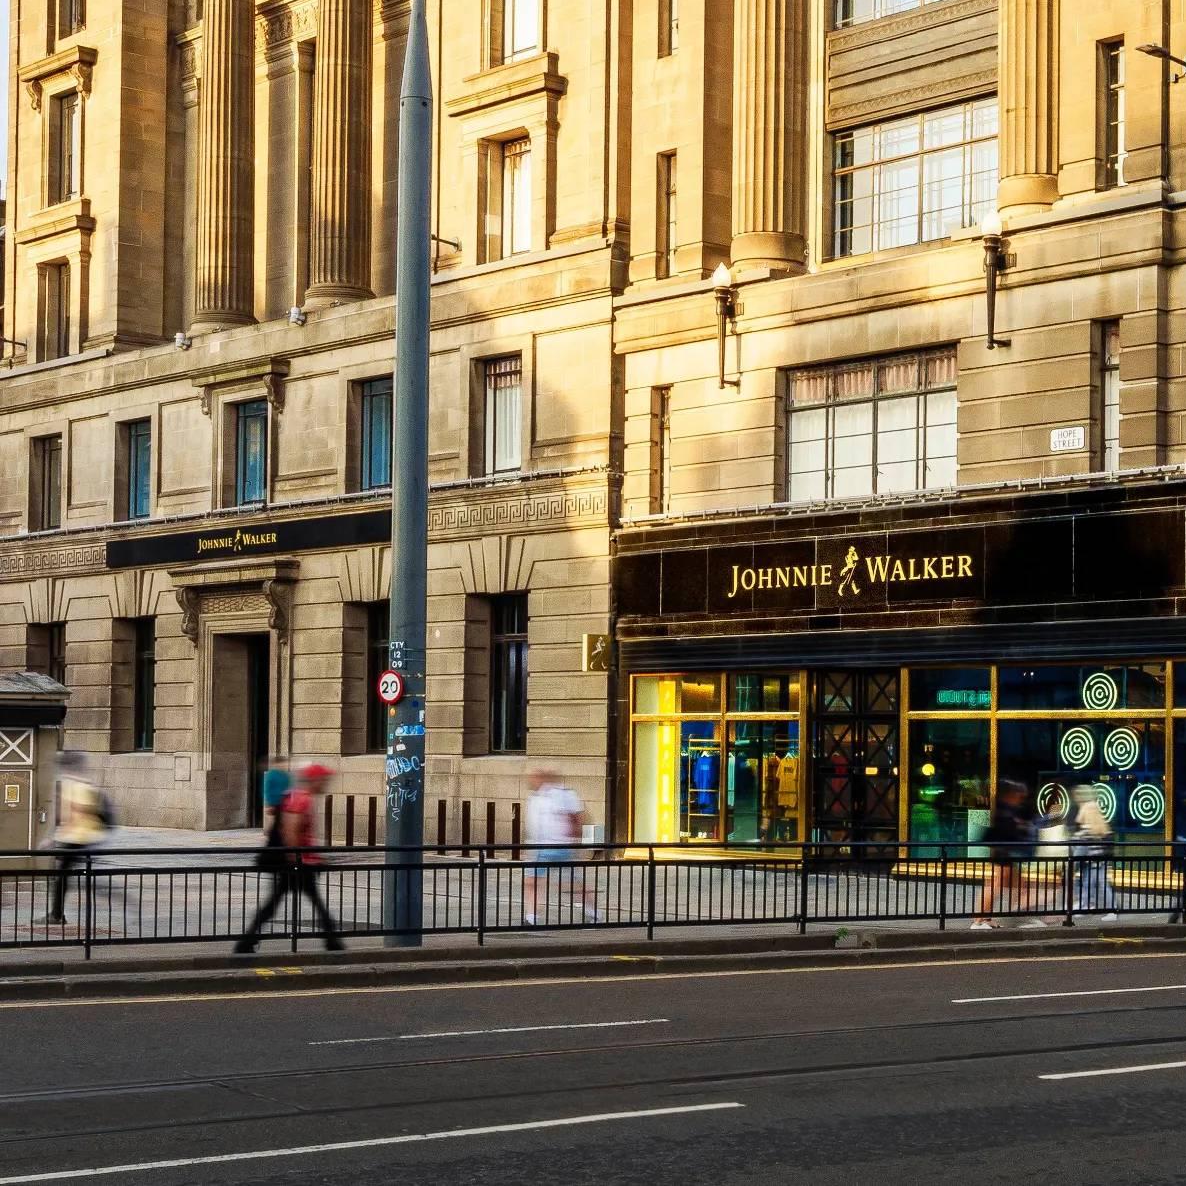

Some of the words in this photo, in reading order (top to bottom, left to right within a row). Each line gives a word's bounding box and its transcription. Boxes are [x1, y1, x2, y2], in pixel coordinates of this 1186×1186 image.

[1057, 429, 1078, 439] HOPE
[1053, 437, 1081, 449] STREET
[197, 537, 233, 554] JOHNNIE
[242, 532, 277, 546] WALKER
[728, 564, 832, 598] JOHNNIE
[865, 555, 973, 583] WALKER
[390, 641, 405, 649] CTY
[393, 650, 401, 659] 12
[391, 660, 403, 668] 09
[381, 680, 398, 694] 20
